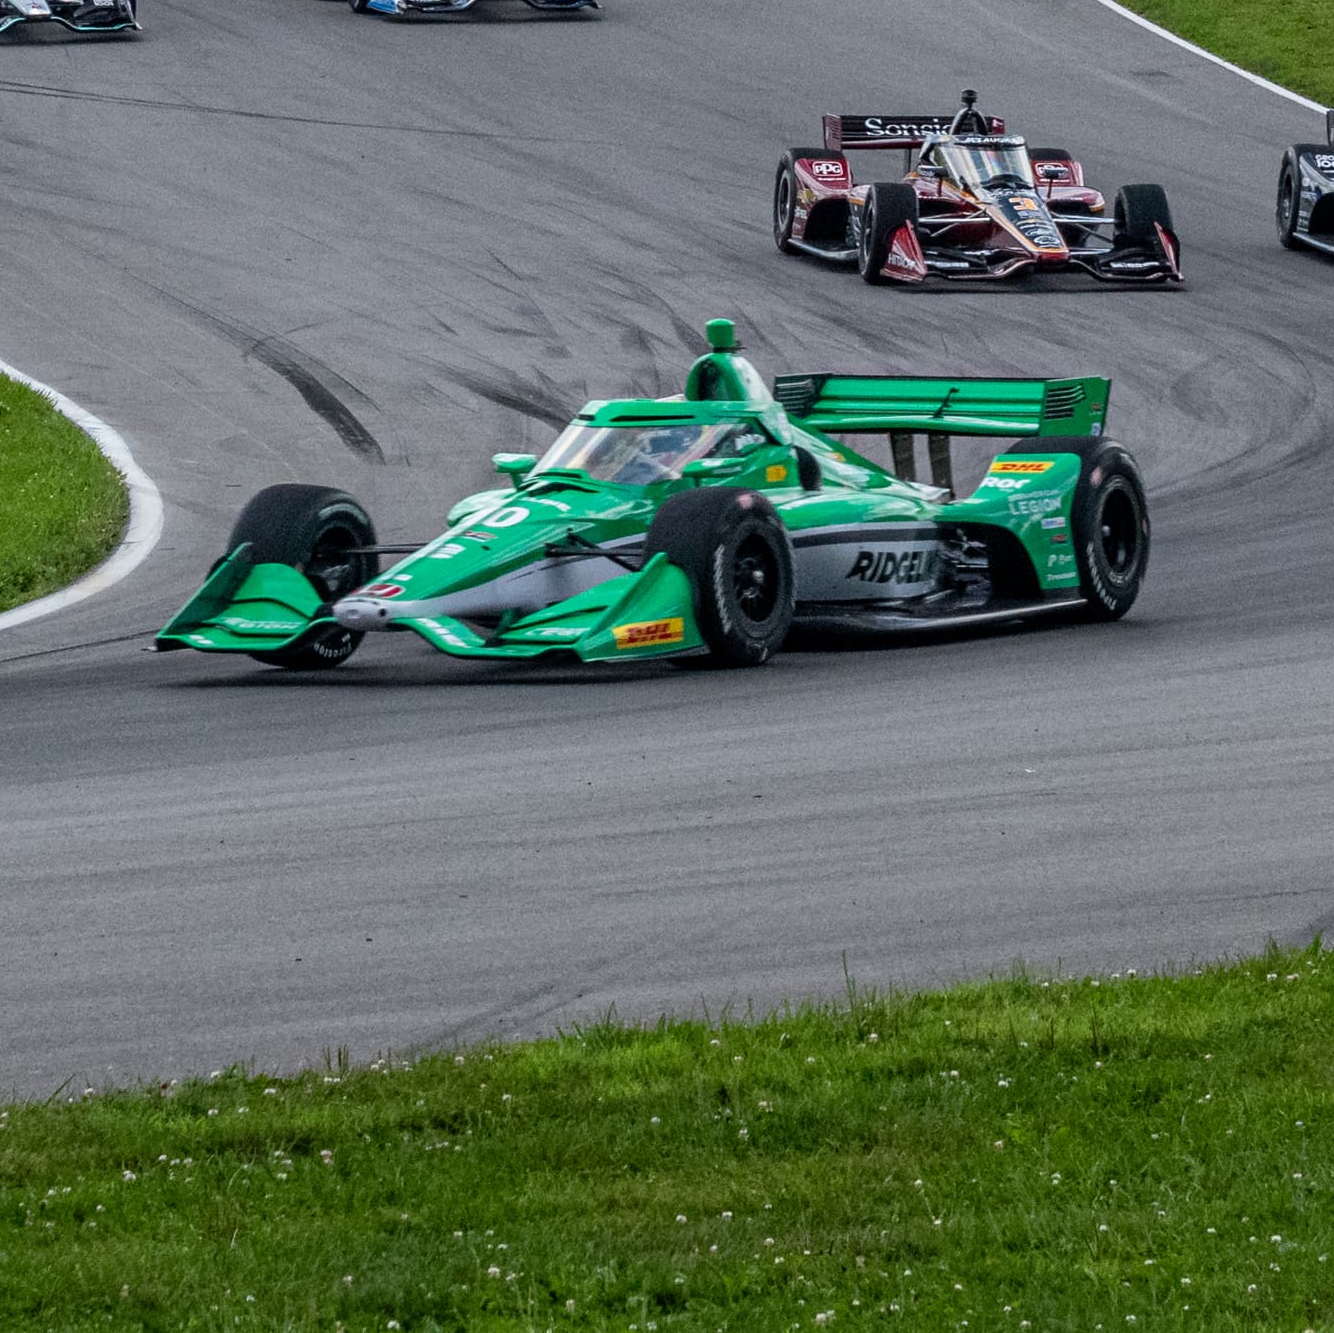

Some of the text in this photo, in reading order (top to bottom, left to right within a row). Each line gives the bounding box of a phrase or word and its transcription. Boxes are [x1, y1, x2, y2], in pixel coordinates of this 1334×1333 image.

[815, 162, 841, 175] PPG
[1009, 197, 1040, 211] 3
[1000, 463, 1045, 471] DHL
